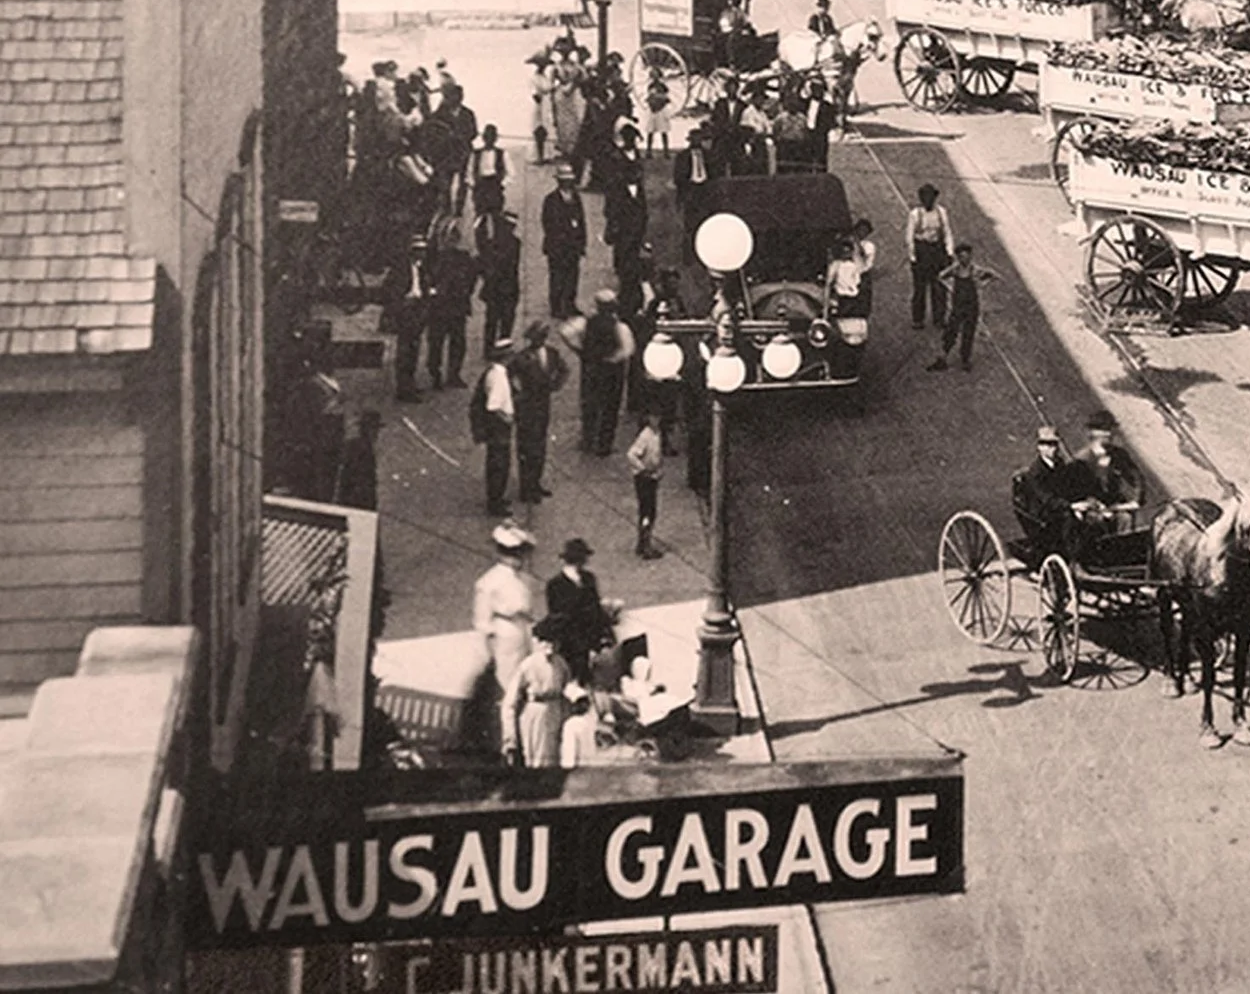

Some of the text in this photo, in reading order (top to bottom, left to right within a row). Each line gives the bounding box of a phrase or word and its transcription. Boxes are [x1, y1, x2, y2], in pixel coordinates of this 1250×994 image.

[1072, 71, 1128, 89] WAUSAU
[1140, 80, 1165, 96] ICE
[1110, 162, 1187, 185] WAUSAU
[1197, 172, 1231, 191] ICE
[199, 793, 938, 935] WAUSAU GARAGE
[449, 937, 764, 994] JUNKERMANN
